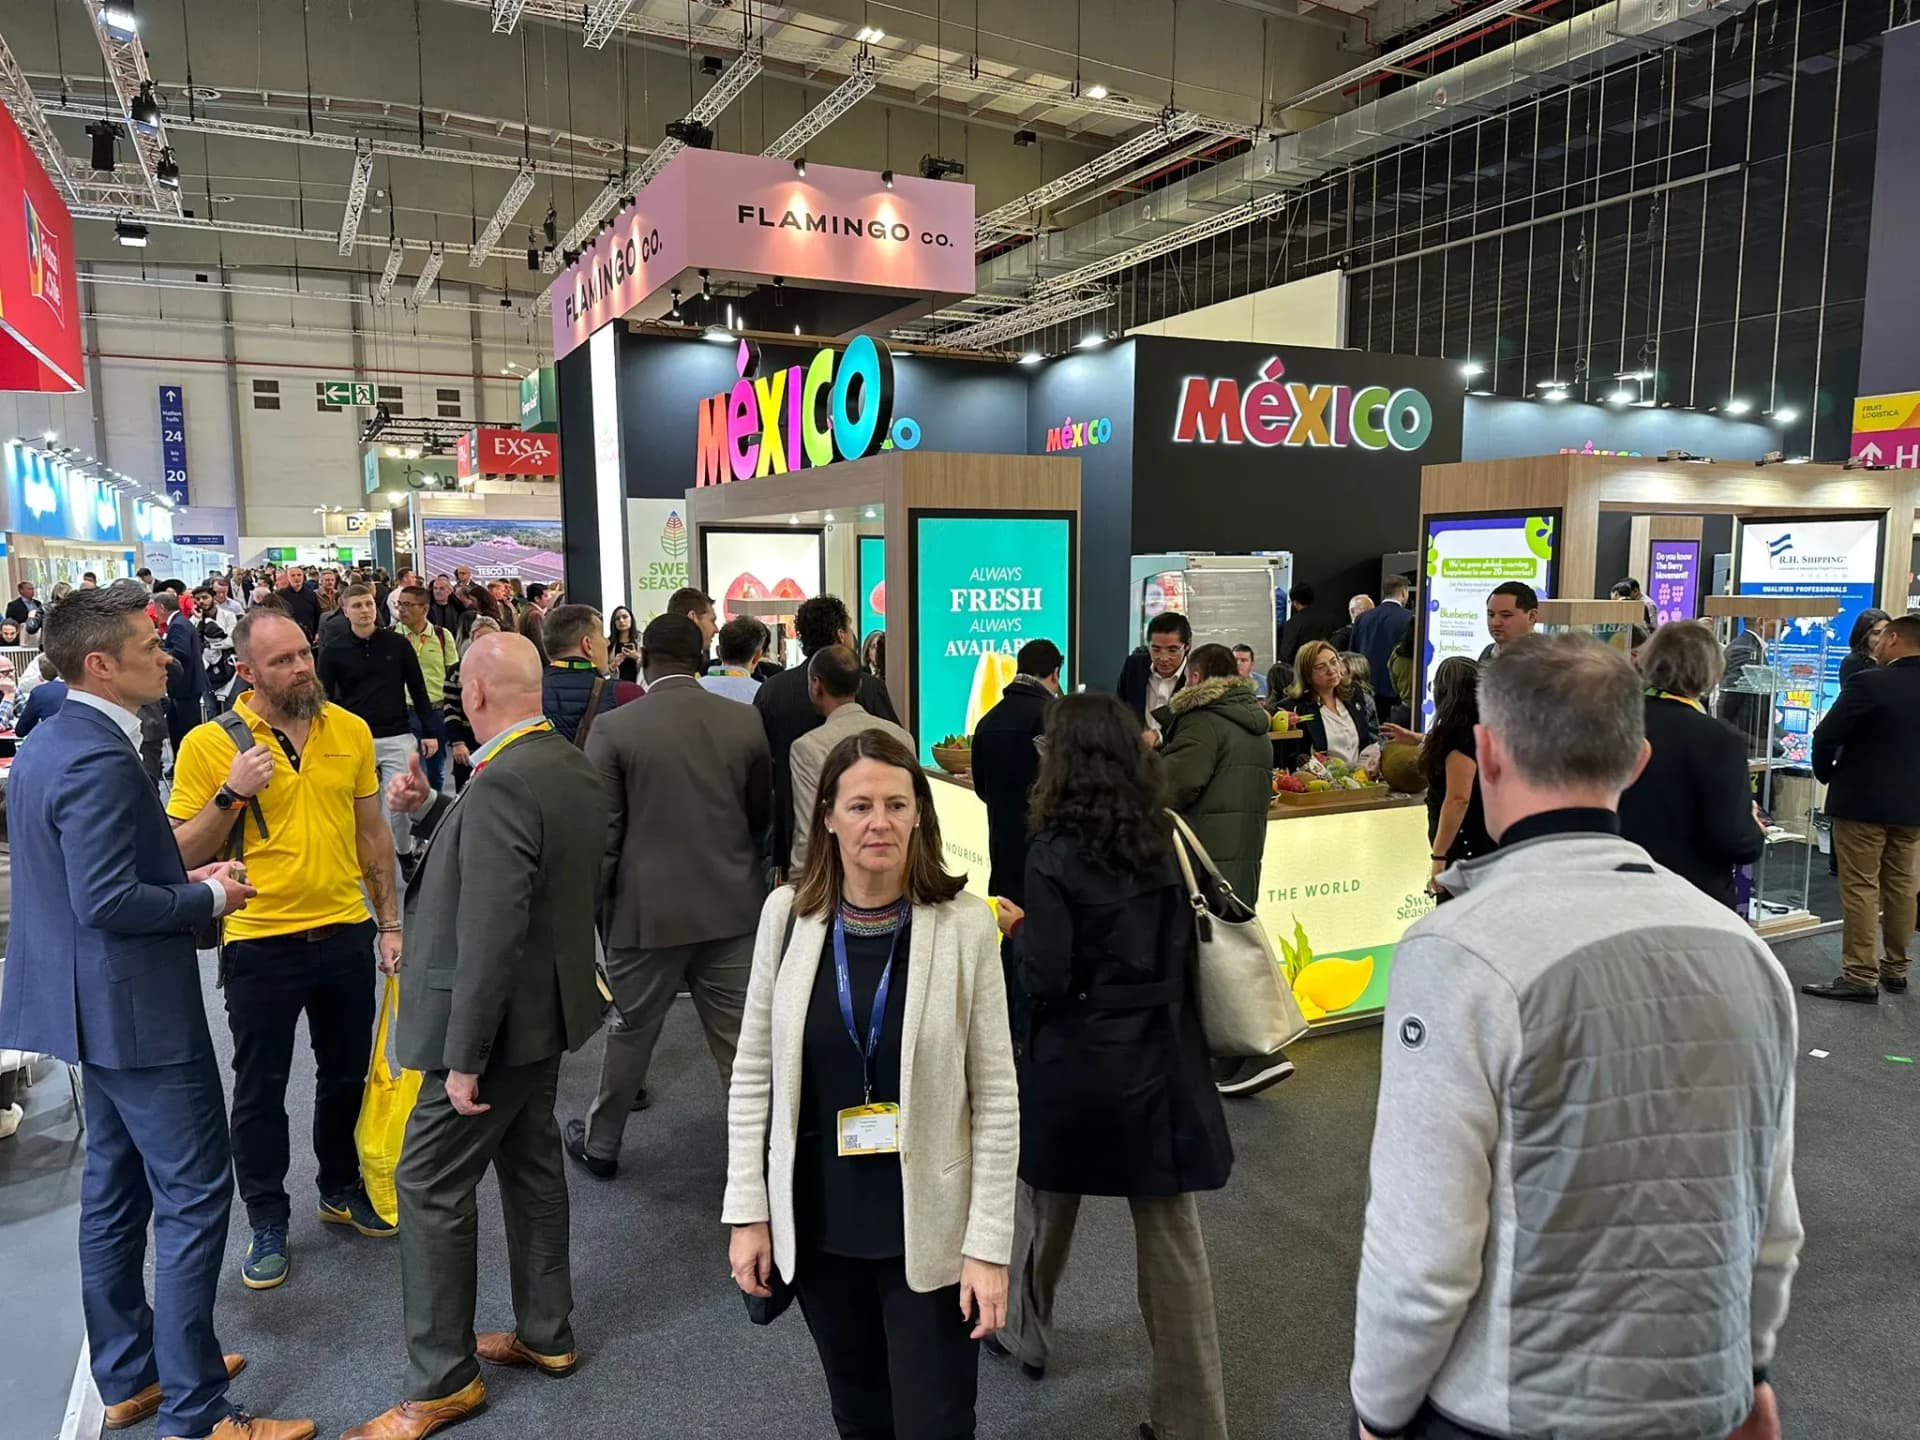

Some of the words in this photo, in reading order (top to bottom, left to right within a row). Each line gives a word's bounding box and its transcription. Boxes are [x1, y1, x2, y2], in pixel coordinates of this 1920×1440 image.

[737, 204, 911, 242] FLAMINGO
[920, 231, 954, 248] CO.
[564, 238, 637, 329] FLAMINGO
[641, 228, 663, 263] CO.
[1862, 404, 1882, 412] FRUIT
[1862, 409, 1899, 419] LOGISTICA
[164, 430, 183, 442] 24
[494, 437, 545, 456] EXSA
[166, 470, 186, 482] 20
[1656, 552, 1665, 561] Do
[1666, 553, 1676, 562] you
[1676, 552, 1693, 561] know
[1493, 567, 1502, 576] 20
[1656, 562, 1667, 570] The
[969, 566, 1022, 581] ALWAYS
[1762, 585, 1794, 593] QUALIFIED
[1795, 585, 1847, 593] PROFESSIONALS
[950, 588, 1043, 612] FRESH
[1440, 608, 1479, 619] Blueberries
[969, 618, 1022, 633] ALWAYS
[944, 638, 1038, 657] AVAILAB
[1439, 640, 1462, 654] Jumbo
[945, 841, 983, 865] NOURISH
[1267, 887, 1298, 902] THE
[1305, 879, 1361, 898] WORLD
